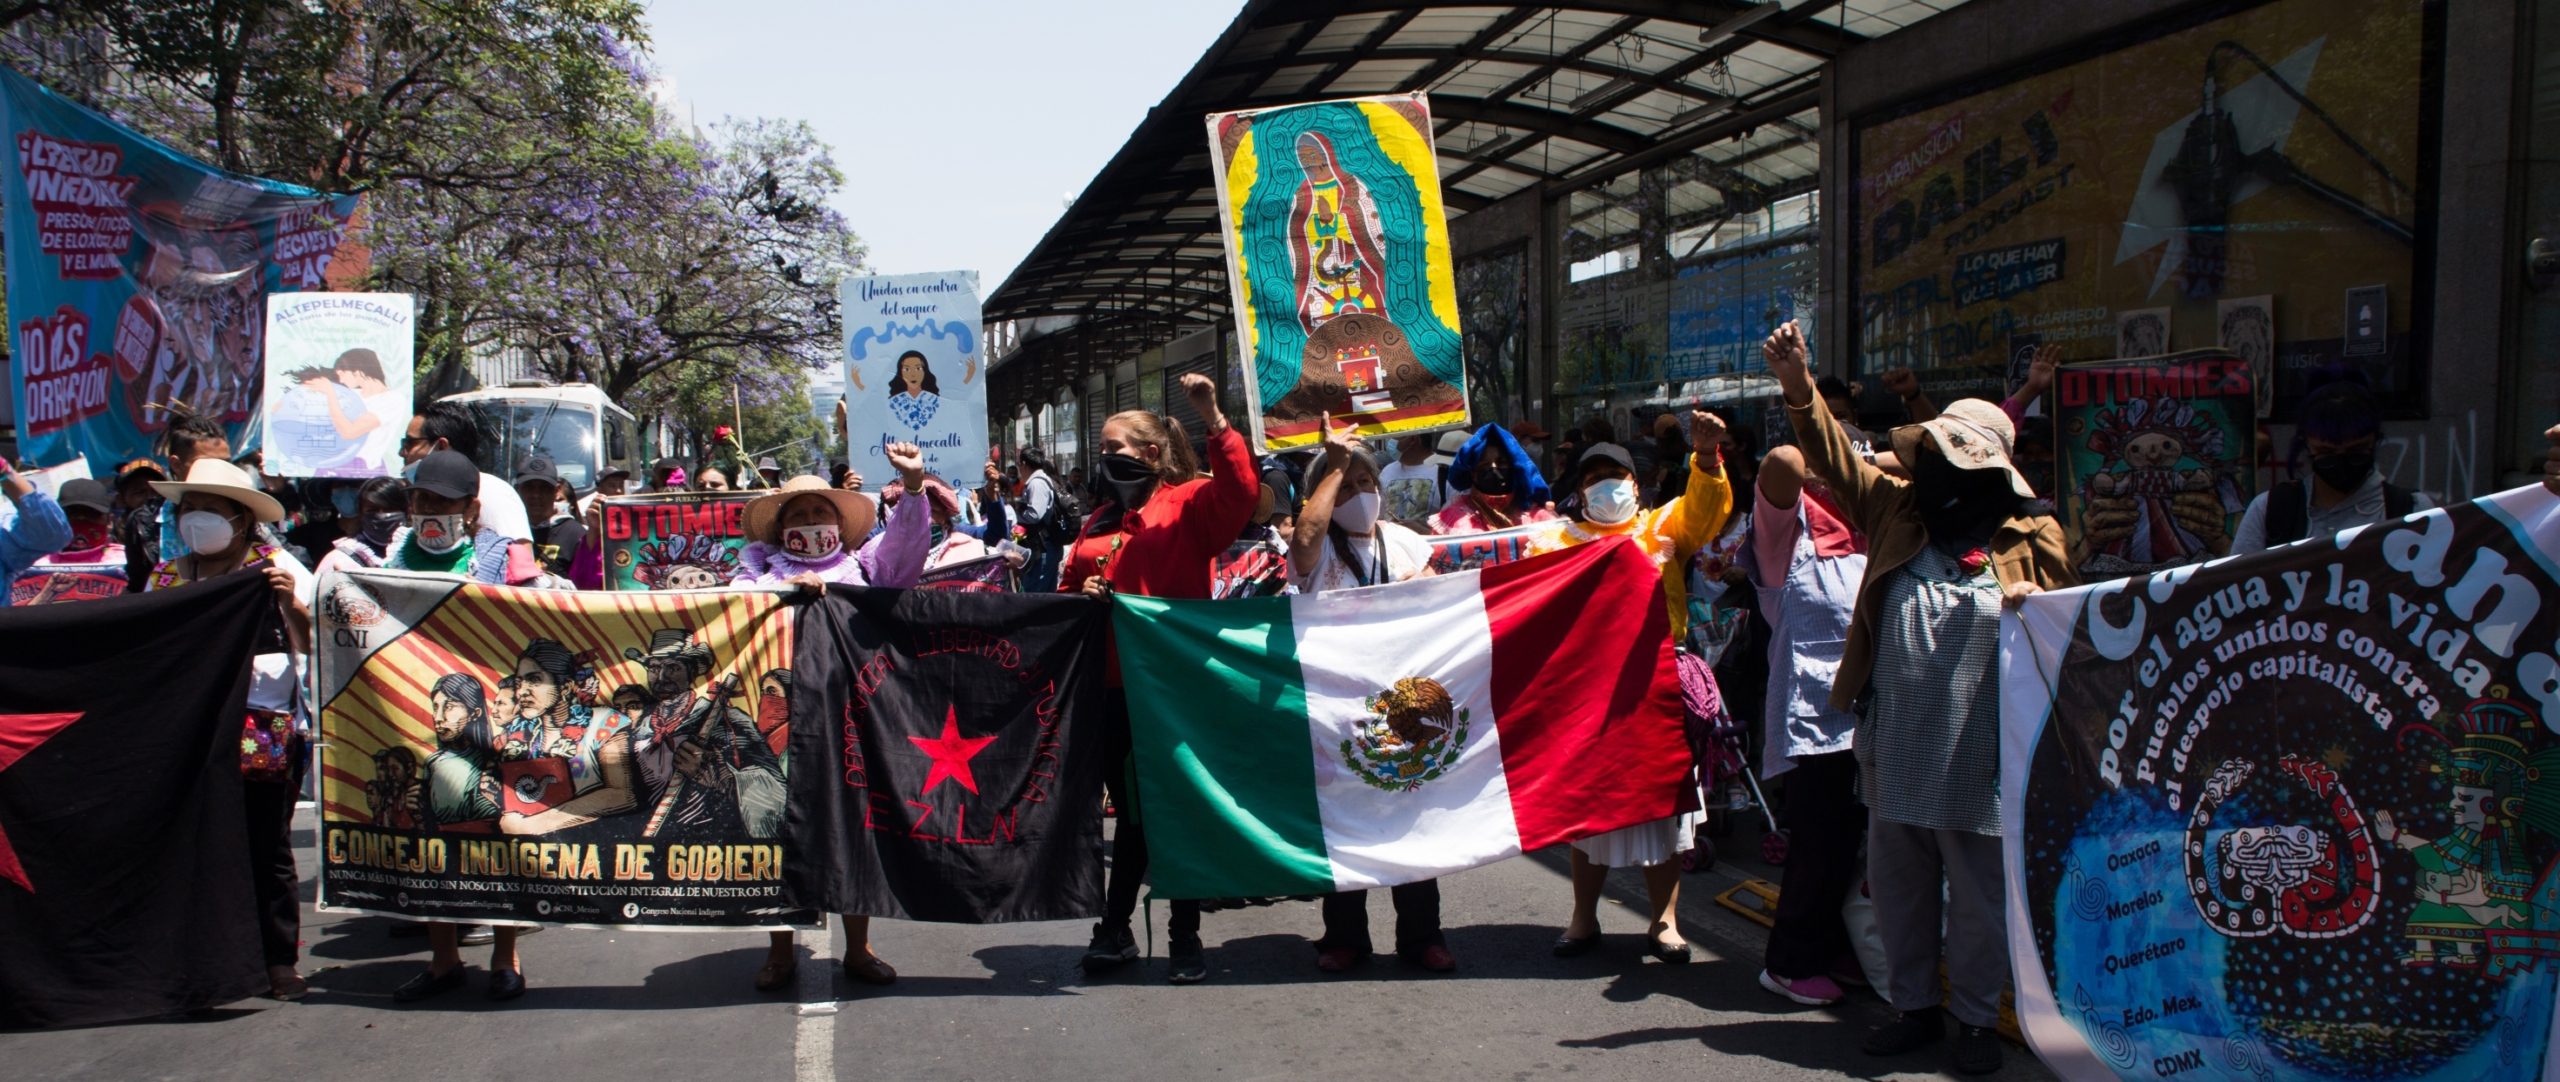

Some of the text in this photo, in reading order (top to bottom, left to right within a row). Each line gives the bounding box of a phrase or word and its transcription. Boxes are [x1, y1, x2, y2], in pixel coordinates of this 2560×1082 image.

[41, 232, 63, 248] DE
[64, 254, 72, 270] Y
[75, 254, 86, 269] EL
[1963, 243, 2058, 272] LO QUE HAY
[856, 279, 960, 302] Unidas en contra
[275, 298, 407, 325] ALTEPELMECALLI
[880, 302, 899, 315] del
[335, 628, 369, 649] CNI
[2101, 563, 2491, 789] por el agua y la vida
[2137, 615, 2440, 785] Pueblos unidos contra
[2166, 650, 2393, 811] el despojo capitalista
[328, 828, 447, 874] CONCEJO
[460, 838, 602, 880] INDÍGENA
[614, 843, 655, 881] DE
[2107, 839, 2161, 872] Oaxaca
[329, 869, 366, 881] NUNCA
[367, 871, 384, 883] MÁS
[385, 875, 398, 886] UN
[400, 876, 439, 890] MÉXICO
[439, 880, 456, 890] SIN
[458, 880, 520, 893] NOSOTRXS
[528, 883, 628, 896] RECONSTITUCIÓN
[630, 886, 685, 897] INTEGRAL
[686, 886, 700, 897] DE
[701, 886, 761, 898] NUESTROS
[670, 906, 698, 916] Nacional
[2106, 888, 2164, 922] Morelos
[2104, 936, 2186, 975] Querétaro
[2122, 994, 2202, 1029] Edo. Mex.
[2154, 1048, 2206, 1079] CDMX
